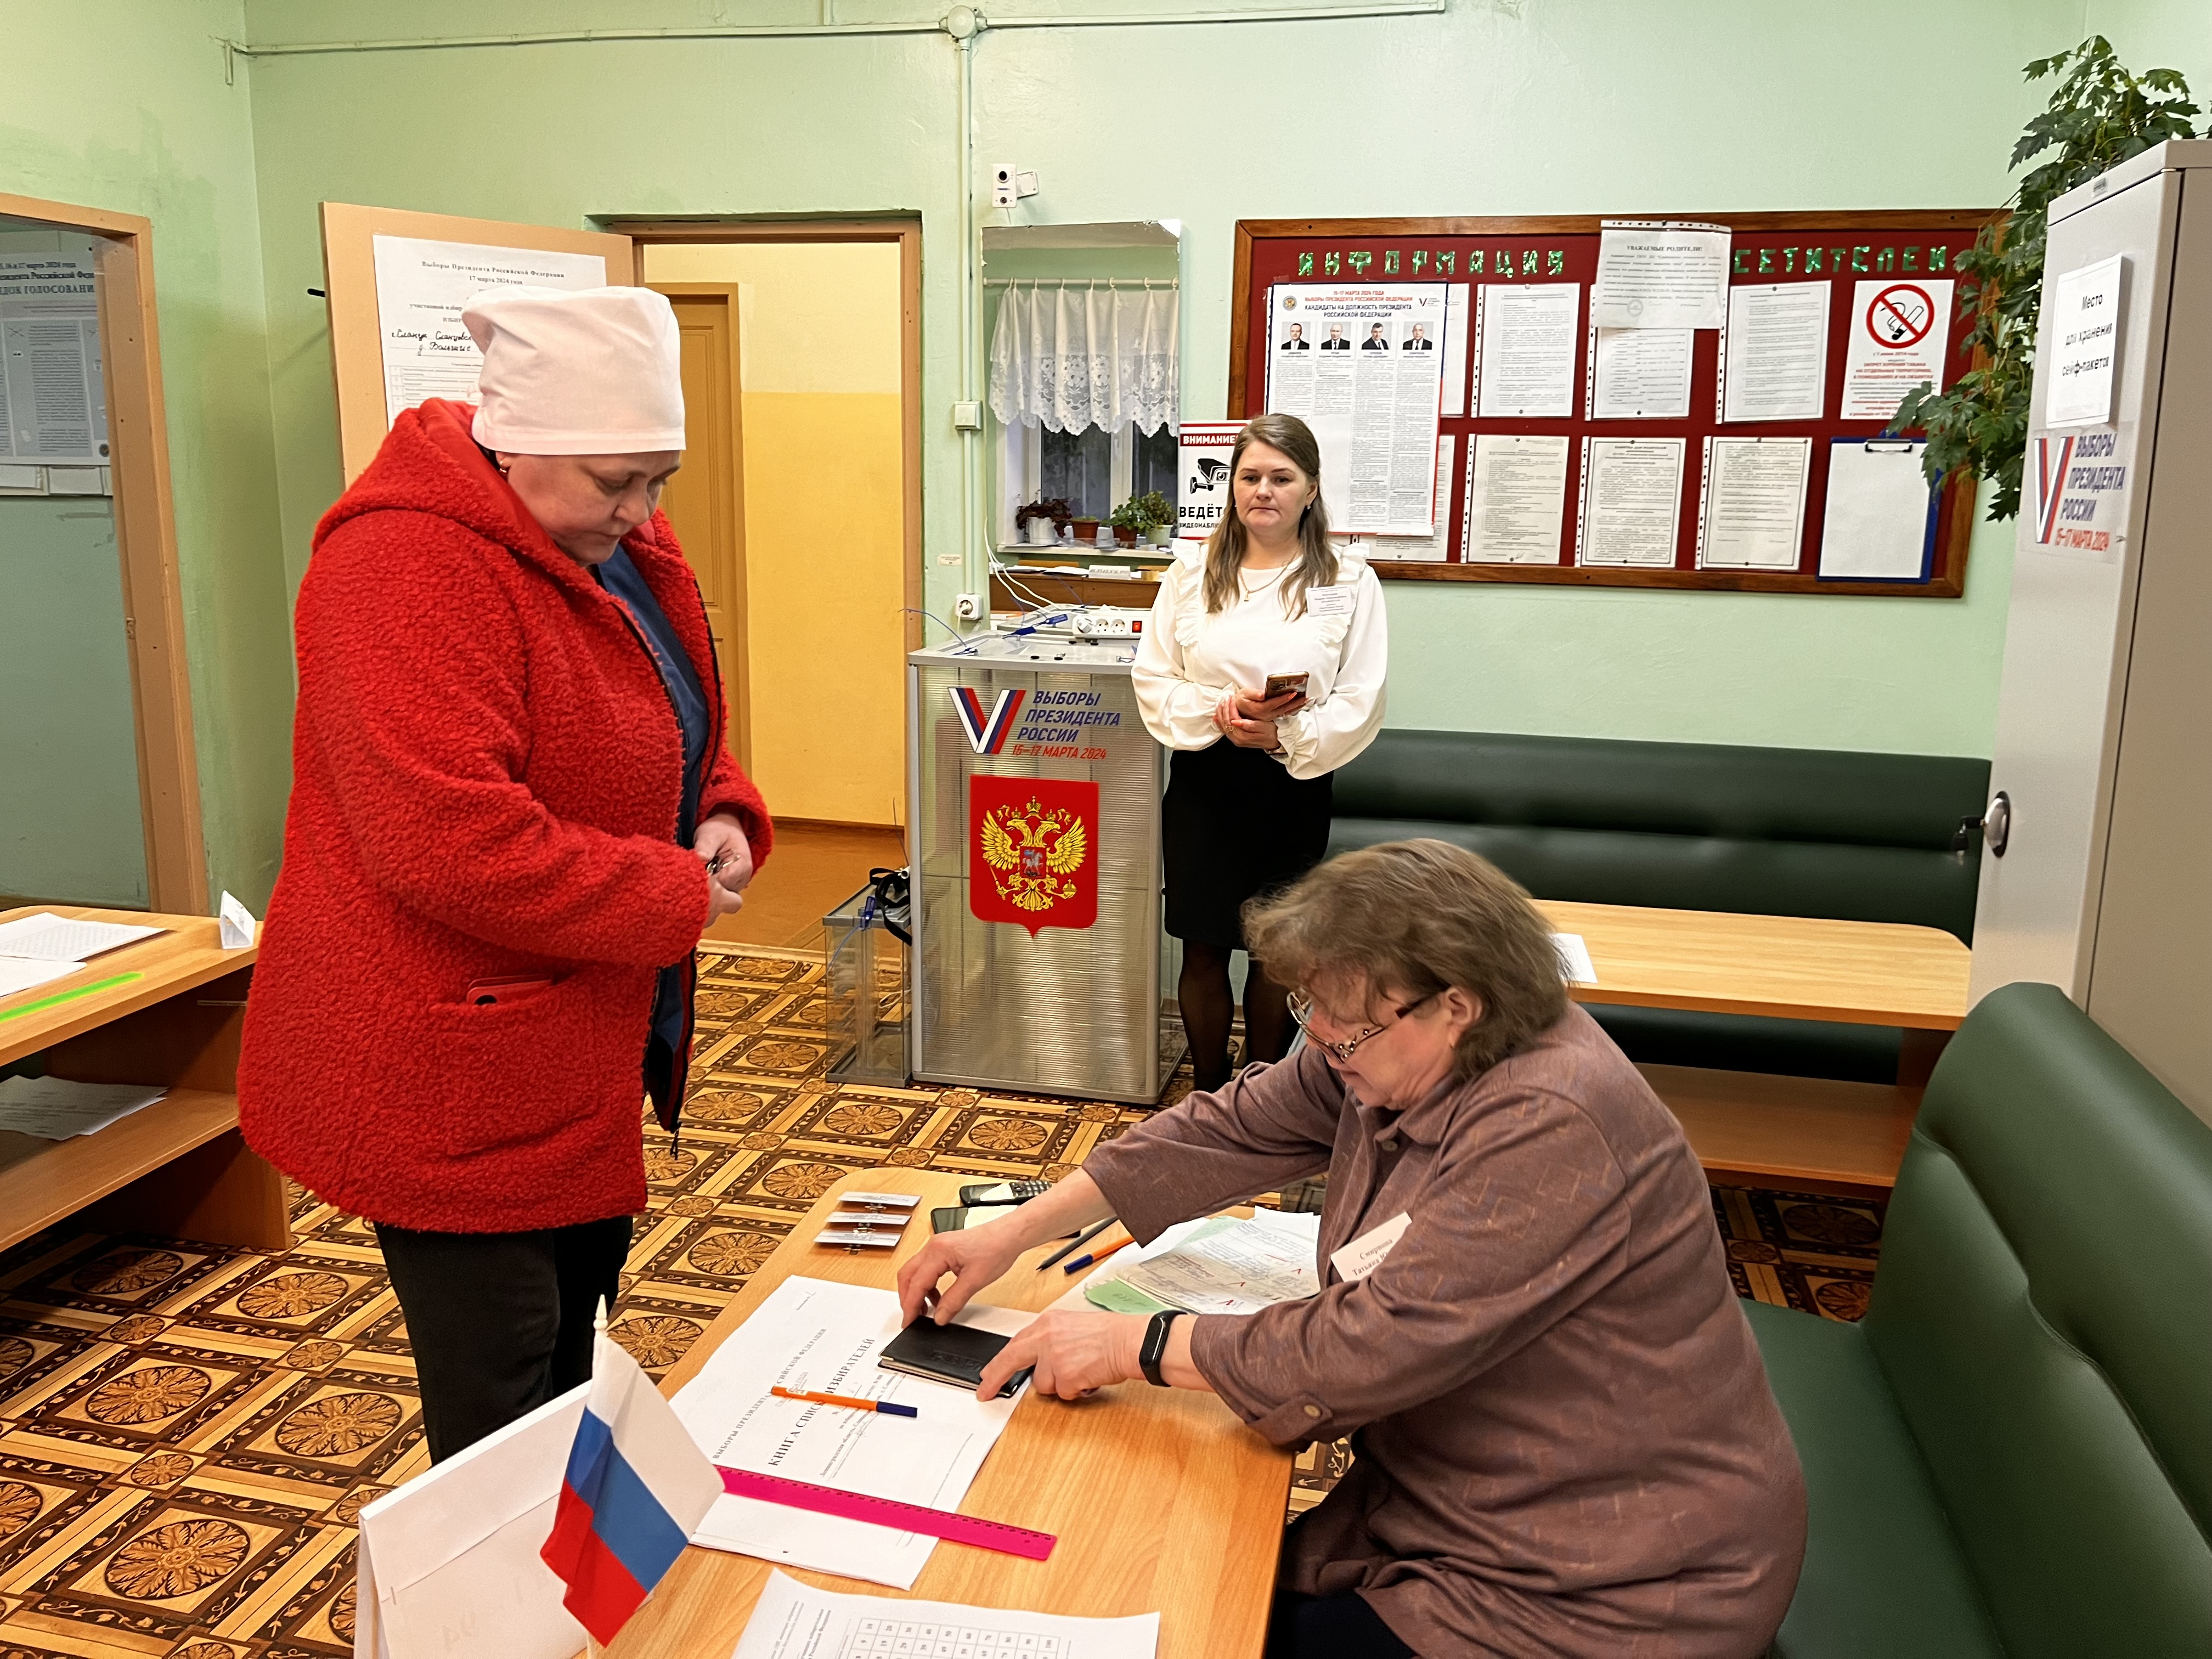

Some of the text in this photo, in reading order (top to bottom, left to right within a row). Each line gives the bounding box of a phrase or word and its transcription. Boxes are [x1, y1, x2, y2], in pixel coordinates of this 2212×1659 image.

[422, 261, 449, 269] Выборы
[452, 263, 489, 272] Президента
[492, 267, 528, 275] Российской
[1299, 251, 1563, 278] ИНФОРМАЦИЯ
[25, 285, 95, 294] ГОЛОСОВАНИ
[2081, 294, 2103, 311] Место
[2079, 323, 2112, 345] хранения
[1183, 435, 1238, 444] ВНИМАНИЕ
[2075, 433, 2117, 458] ВЫБОРЫ
[2067, 466, 2126, 493] ПРЕЗИДЕНТА
[1180, 503, 1223, 520] ВЕДЁТ
[2060, 498, 2097, 522] РОССИИ
[1033, 691, 1101, 706] ВЫБОРЫ
[1025, 709, 1120, 726] ПРЕЗИДЕНТА
[1017, 727, 1079, 742] РОССИИ
[1042, 746, 1079, 758] МАРТА
[1080, 747, 1107, 759] 2024
[1360, 1239, 1393, 1260] Смирнова
[1352, 1258, 1380, 1276] Татьяна
[713, 1430, 738, 1459] ВЫБОРЫ
[799, 1328, 827, 1355] ФЕДЕРАЦИИ
[768, 1431, 801, 1466] КНИГА
[795, 1400, 825, 1427] СПИСК
[825, 1339, 875, 1393] ИЗБИРАТЕЛЕЙ
